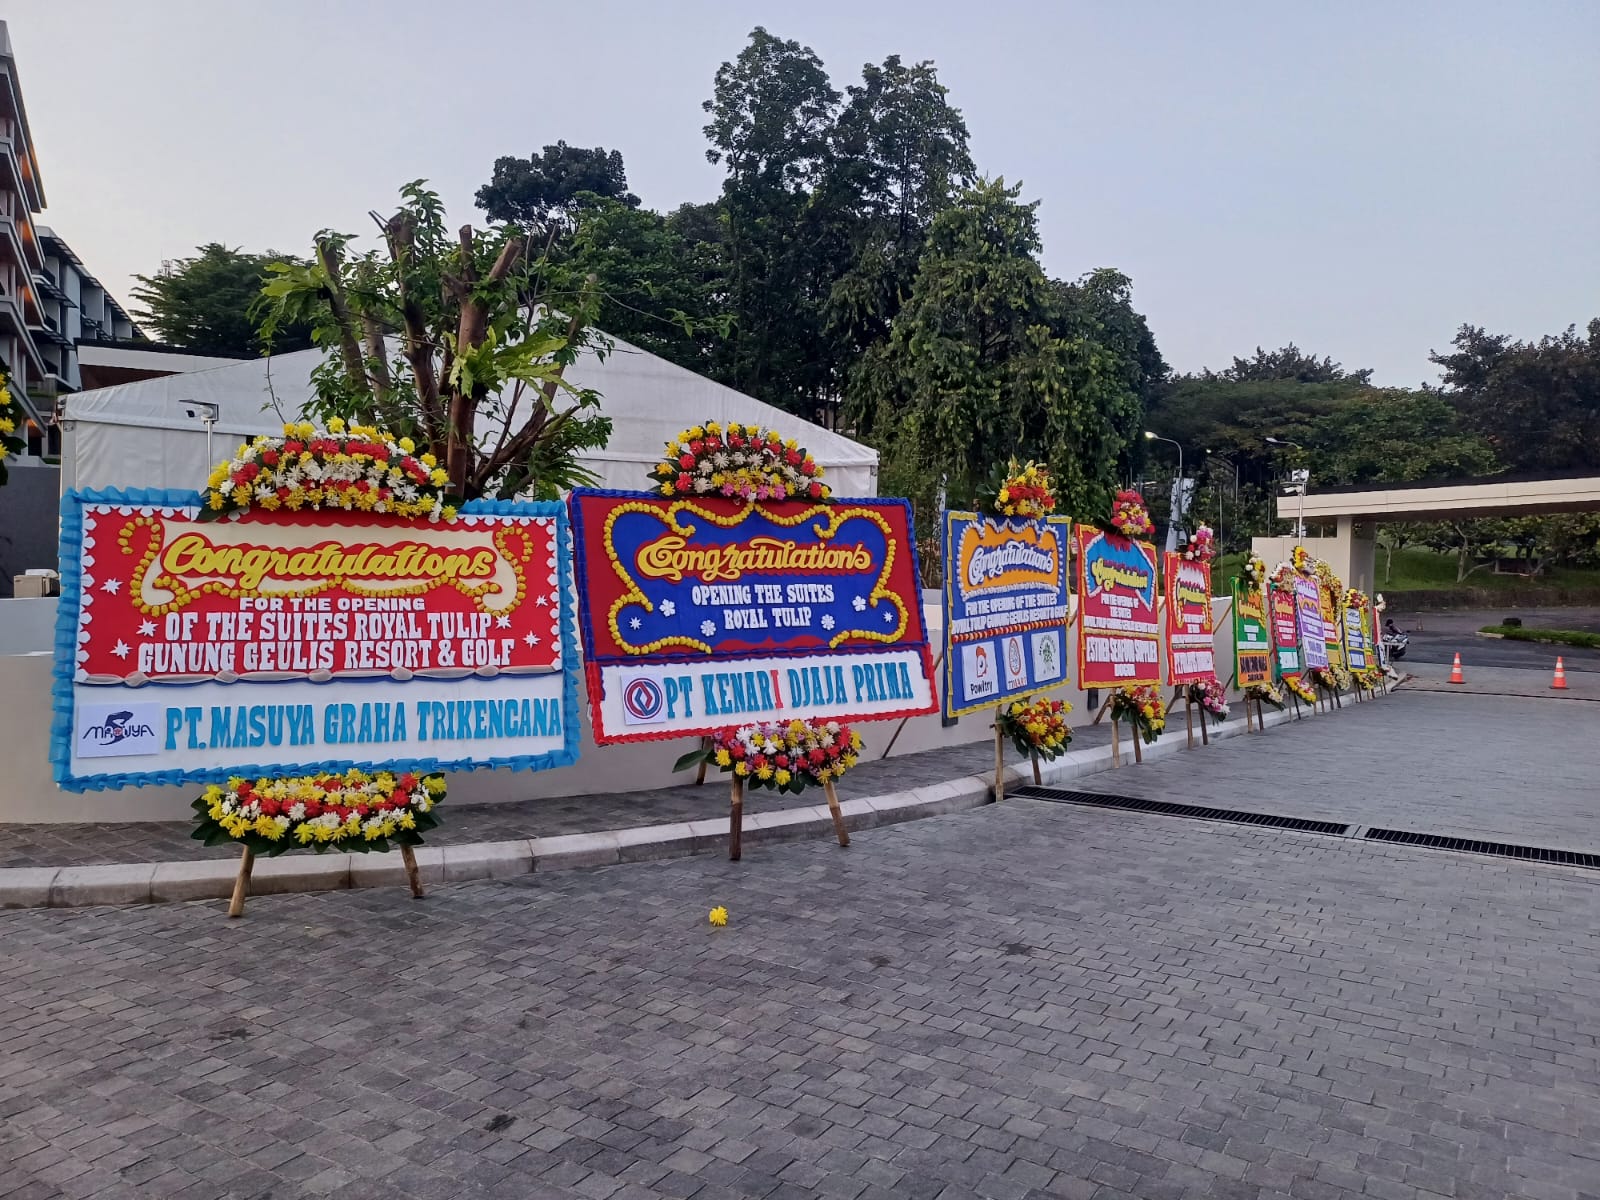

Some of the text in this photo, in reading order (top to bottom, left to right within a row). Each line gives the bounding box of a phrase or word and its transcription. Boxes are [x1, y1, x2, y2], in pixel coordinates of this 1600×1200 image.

[163, 535, 496, 589] Congratulations
[637, 536, 871, 581] Congratulations
[969, 541, 1054, 586] Congratulations
[240, 598, 425, 612] FOR THE OPENING
[692, 584, 835, 605] OPENING THE SUITES
[165, 612, 491, 640] OF THE SUITES ROYAL TULIP
[724, 606, 812, 629] ROYAL TULIP
[138, 638, 515, 672] GUNUNG GEULIS RESORT & GOLF
[664, 662, 913, 718] PT KENARI DJAJA PRIMA
[323, 702, 405, 743] GRAHA
[417, 698, 562, 740] TRIKENCANA
